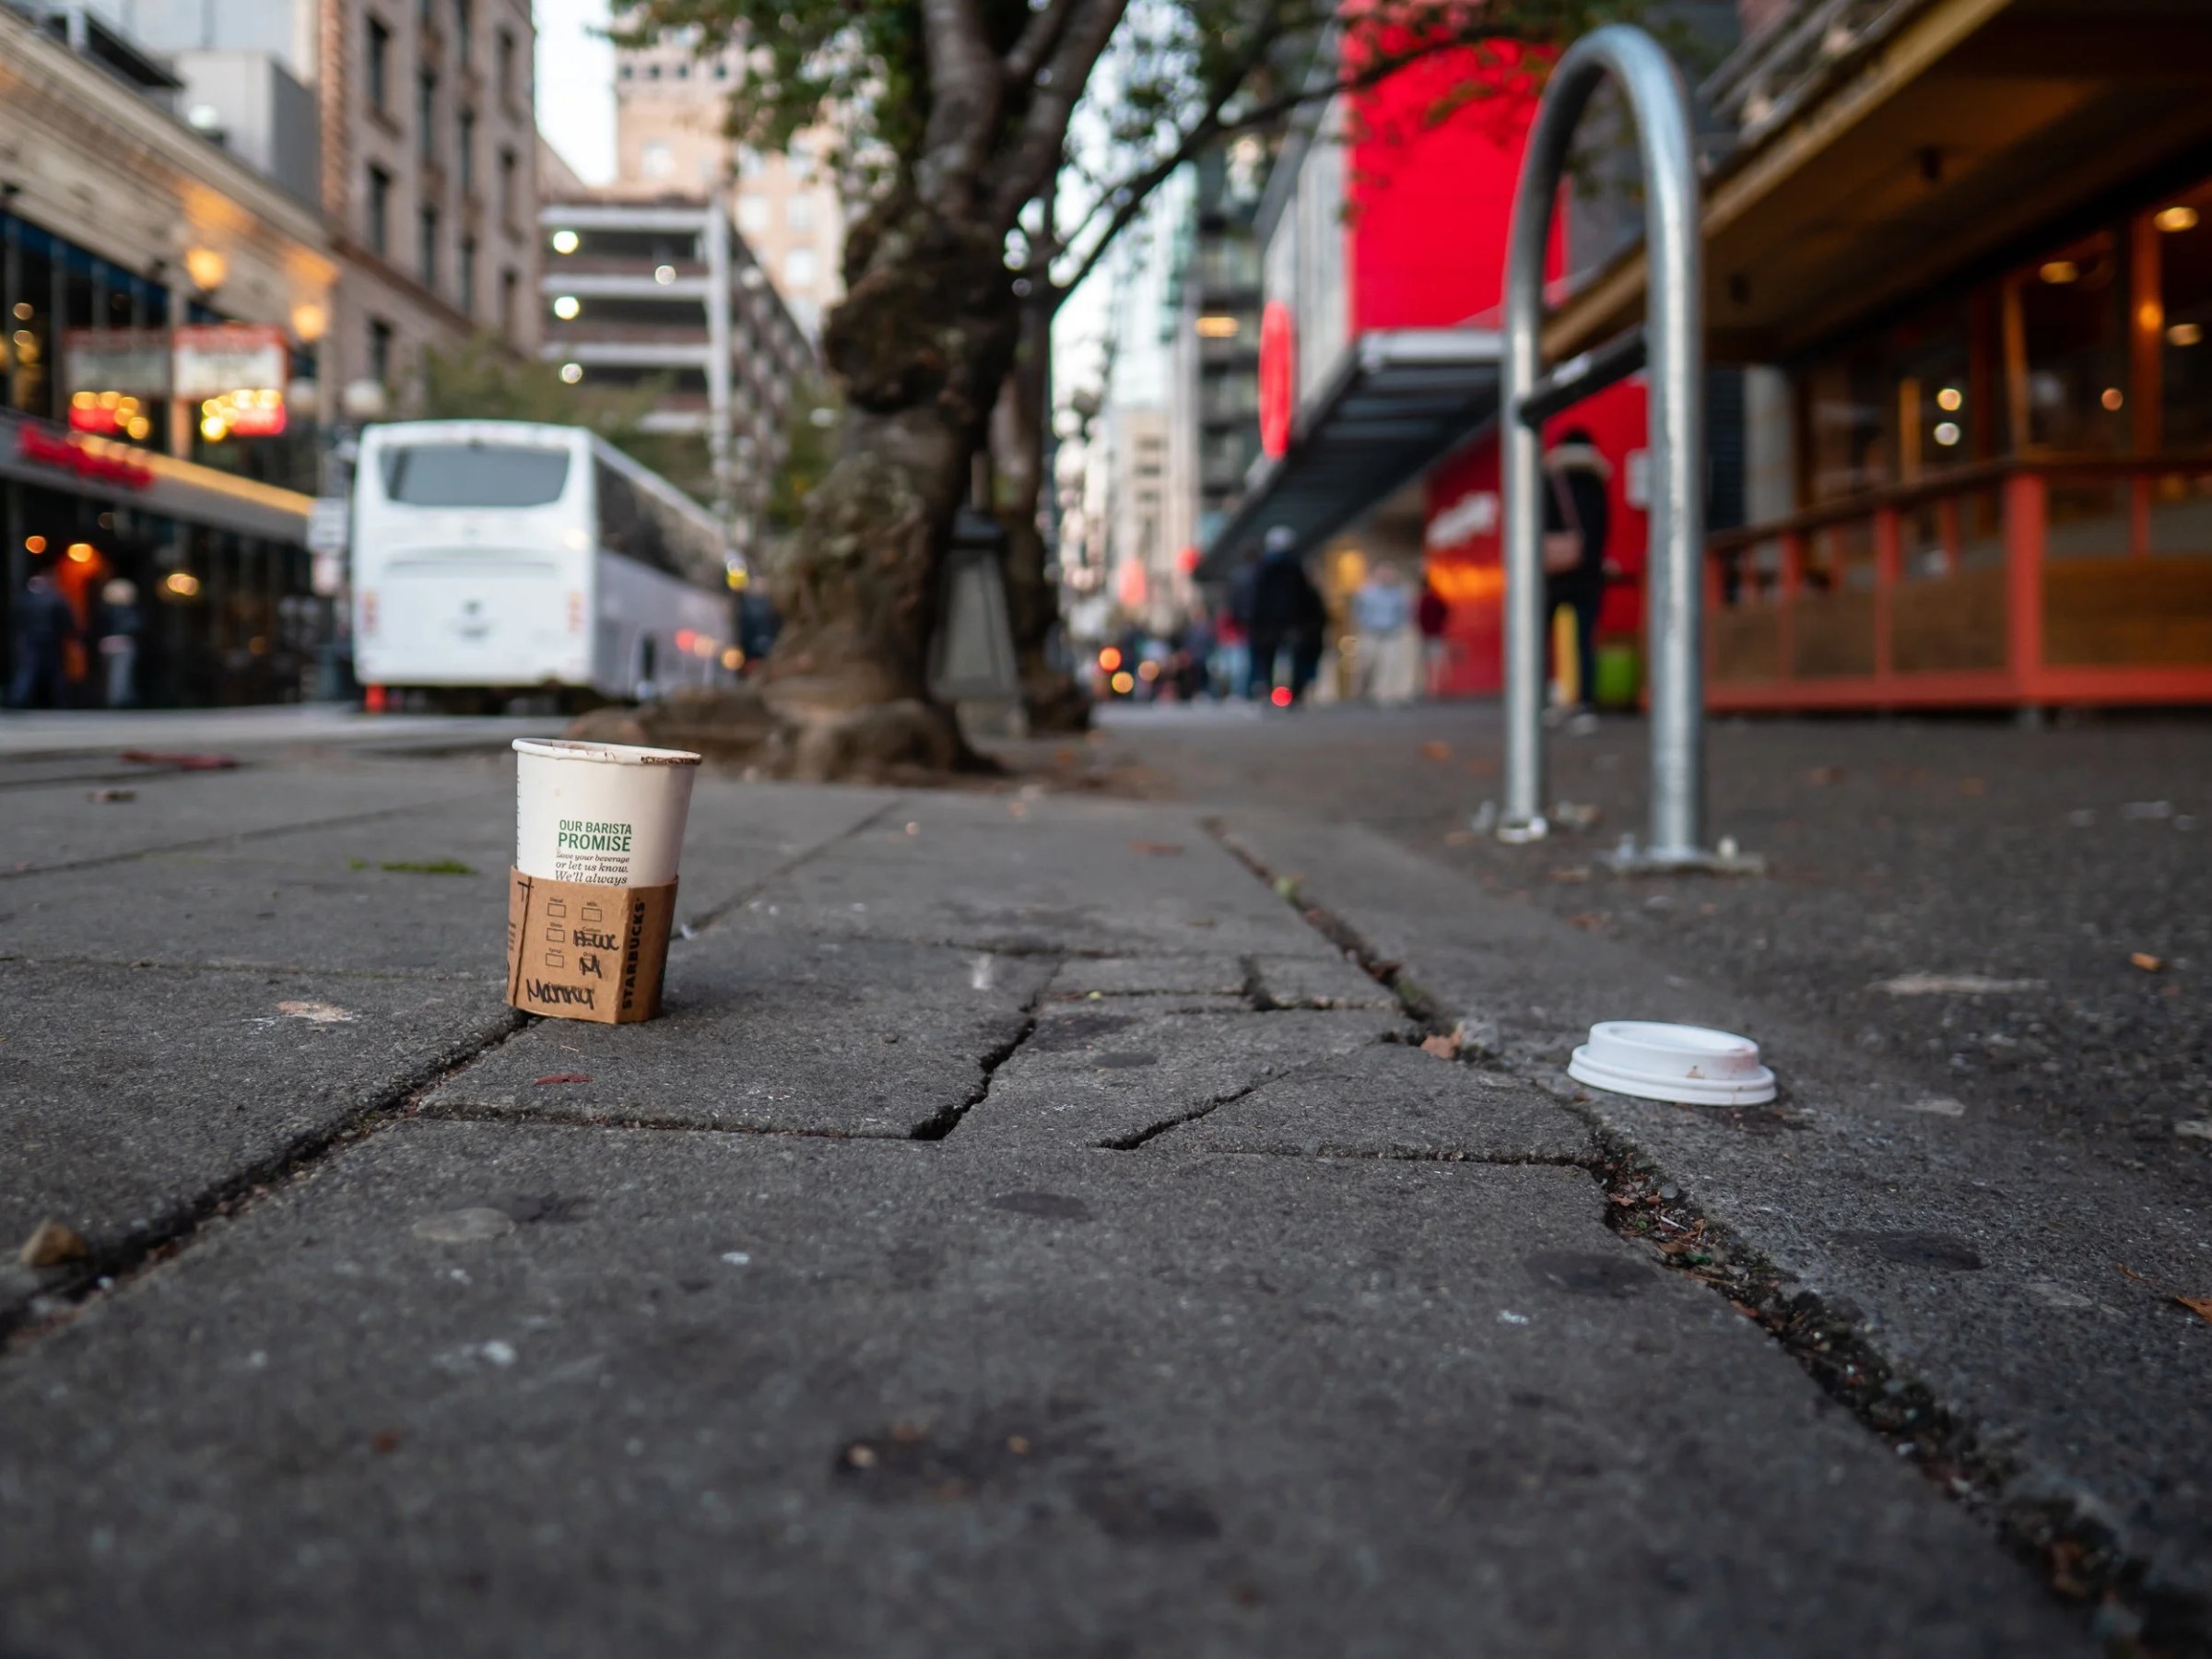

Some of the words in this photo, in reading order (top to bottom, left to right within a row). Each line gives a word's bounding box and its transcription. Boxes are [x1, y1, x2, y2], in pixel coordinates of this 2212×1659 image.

[559, 819, 582, 831] OUR
[585, 821, 632, 835] BARISTA
[558, 831, 632, 852] PROMISE
[568, 861, 582, 870] let
[584, 864, 597, 872] us
[598, 863, 629, 873] know.
[594, 854, 630, 864] beverage
[555, 870, 583, 882] We'll
[584, 873, 629, 886] always
[621, 900, 645, 1009] STARBUCKS
